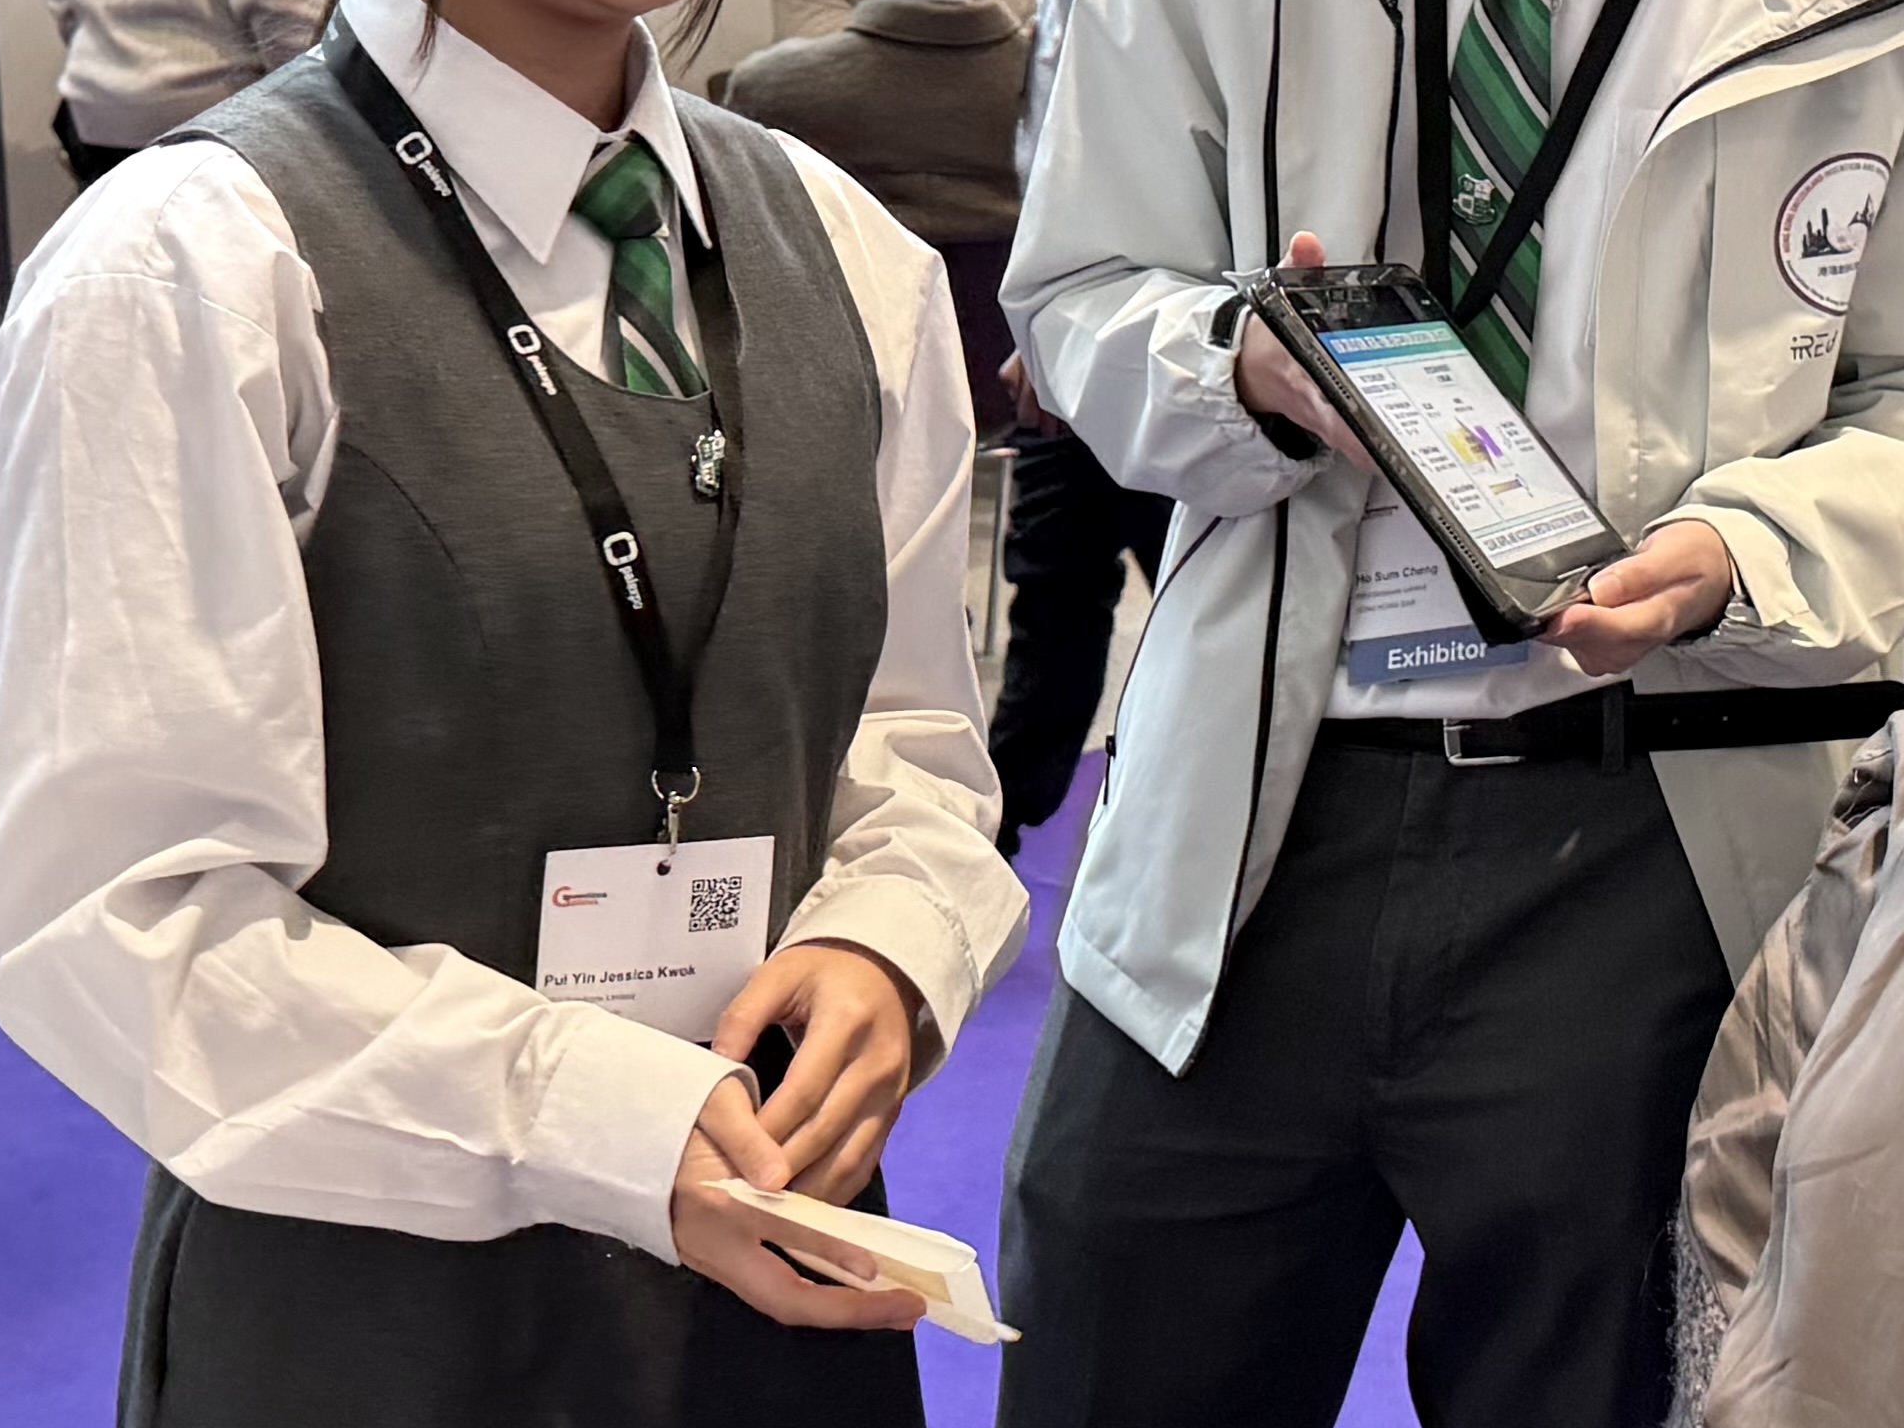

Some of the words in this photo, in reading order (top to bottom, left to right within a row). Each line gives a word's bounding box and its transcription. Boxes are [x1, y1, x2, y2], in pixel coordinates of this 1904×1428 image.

[1388, 641, 1488, 670] Exhibitor
[572, 972, 596, 985] Yin
[599, 968, 654, 984] Jessica
[657, 965, 696, 978] Kwok
